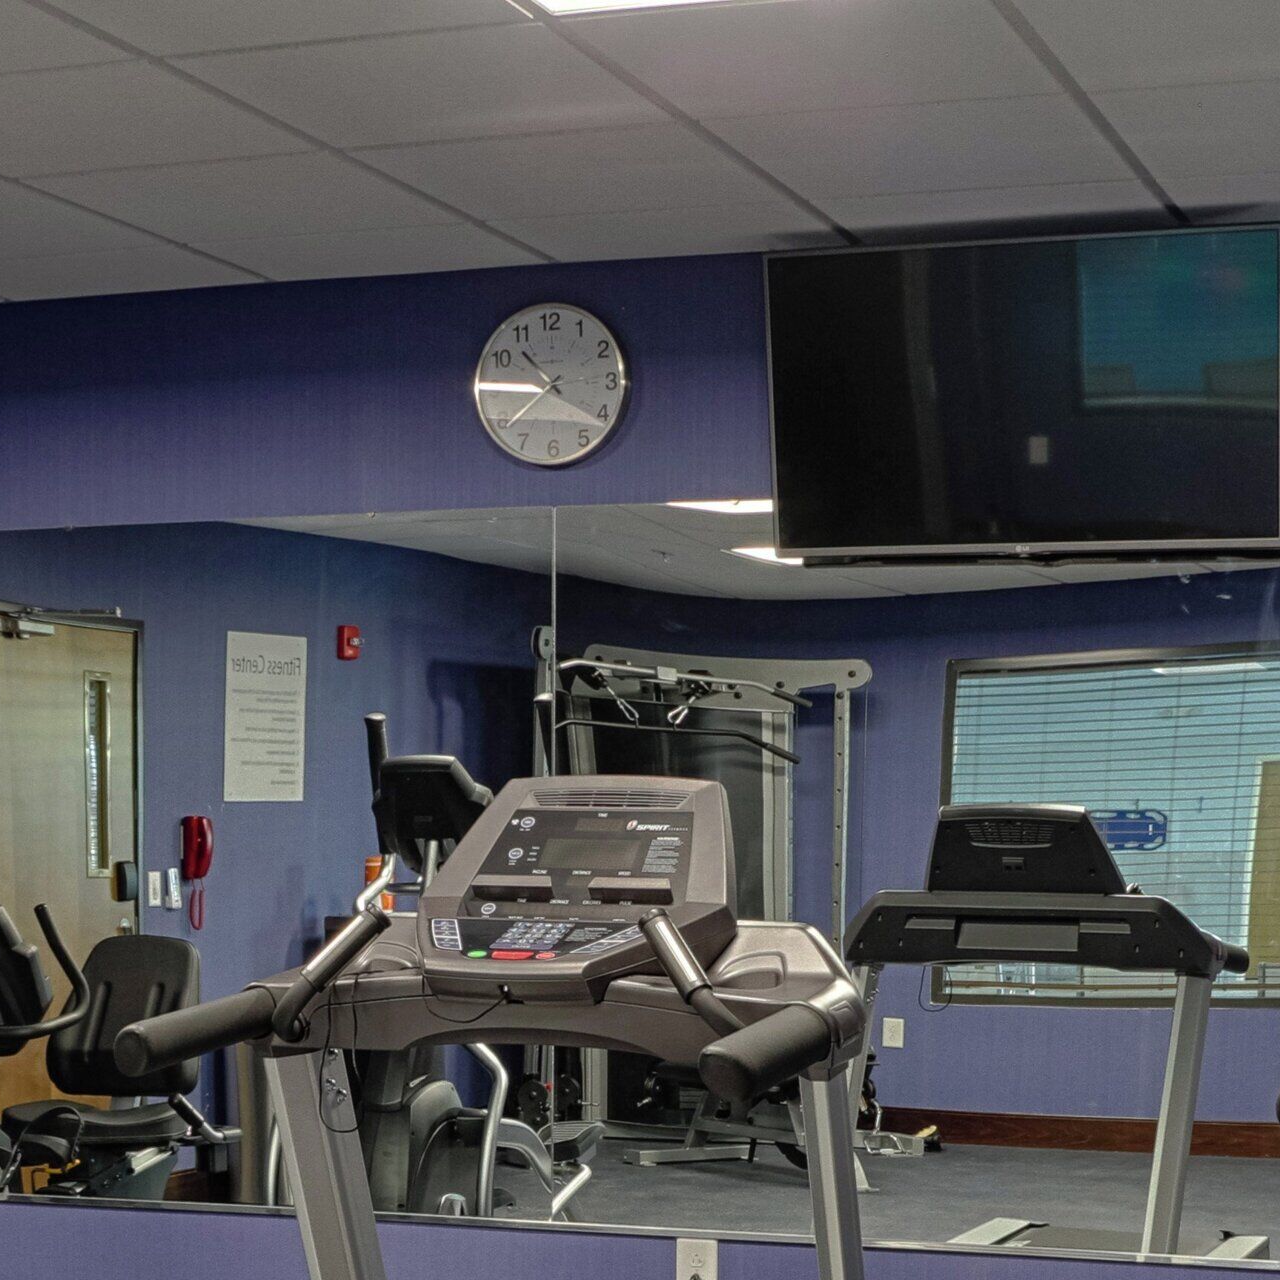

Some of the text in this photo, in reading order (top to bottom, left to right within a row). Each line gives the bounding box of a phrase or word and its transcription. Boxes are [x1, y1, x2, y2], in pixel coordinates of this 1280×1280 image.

[539, 312, 561, 331] 12
[575, 320, 583, 337] 1
[513, 324, 529, 343] 11
[597, 340, 609, 358] 2
[492, 350, 511, 368] 10
[605, 372, 617, 390] 3
[597, 404, 609, 421] 4
[518, 433, 529, 450] 7
[577, 429, 590, 447] 5
[547, 440, 559, 457] 6
